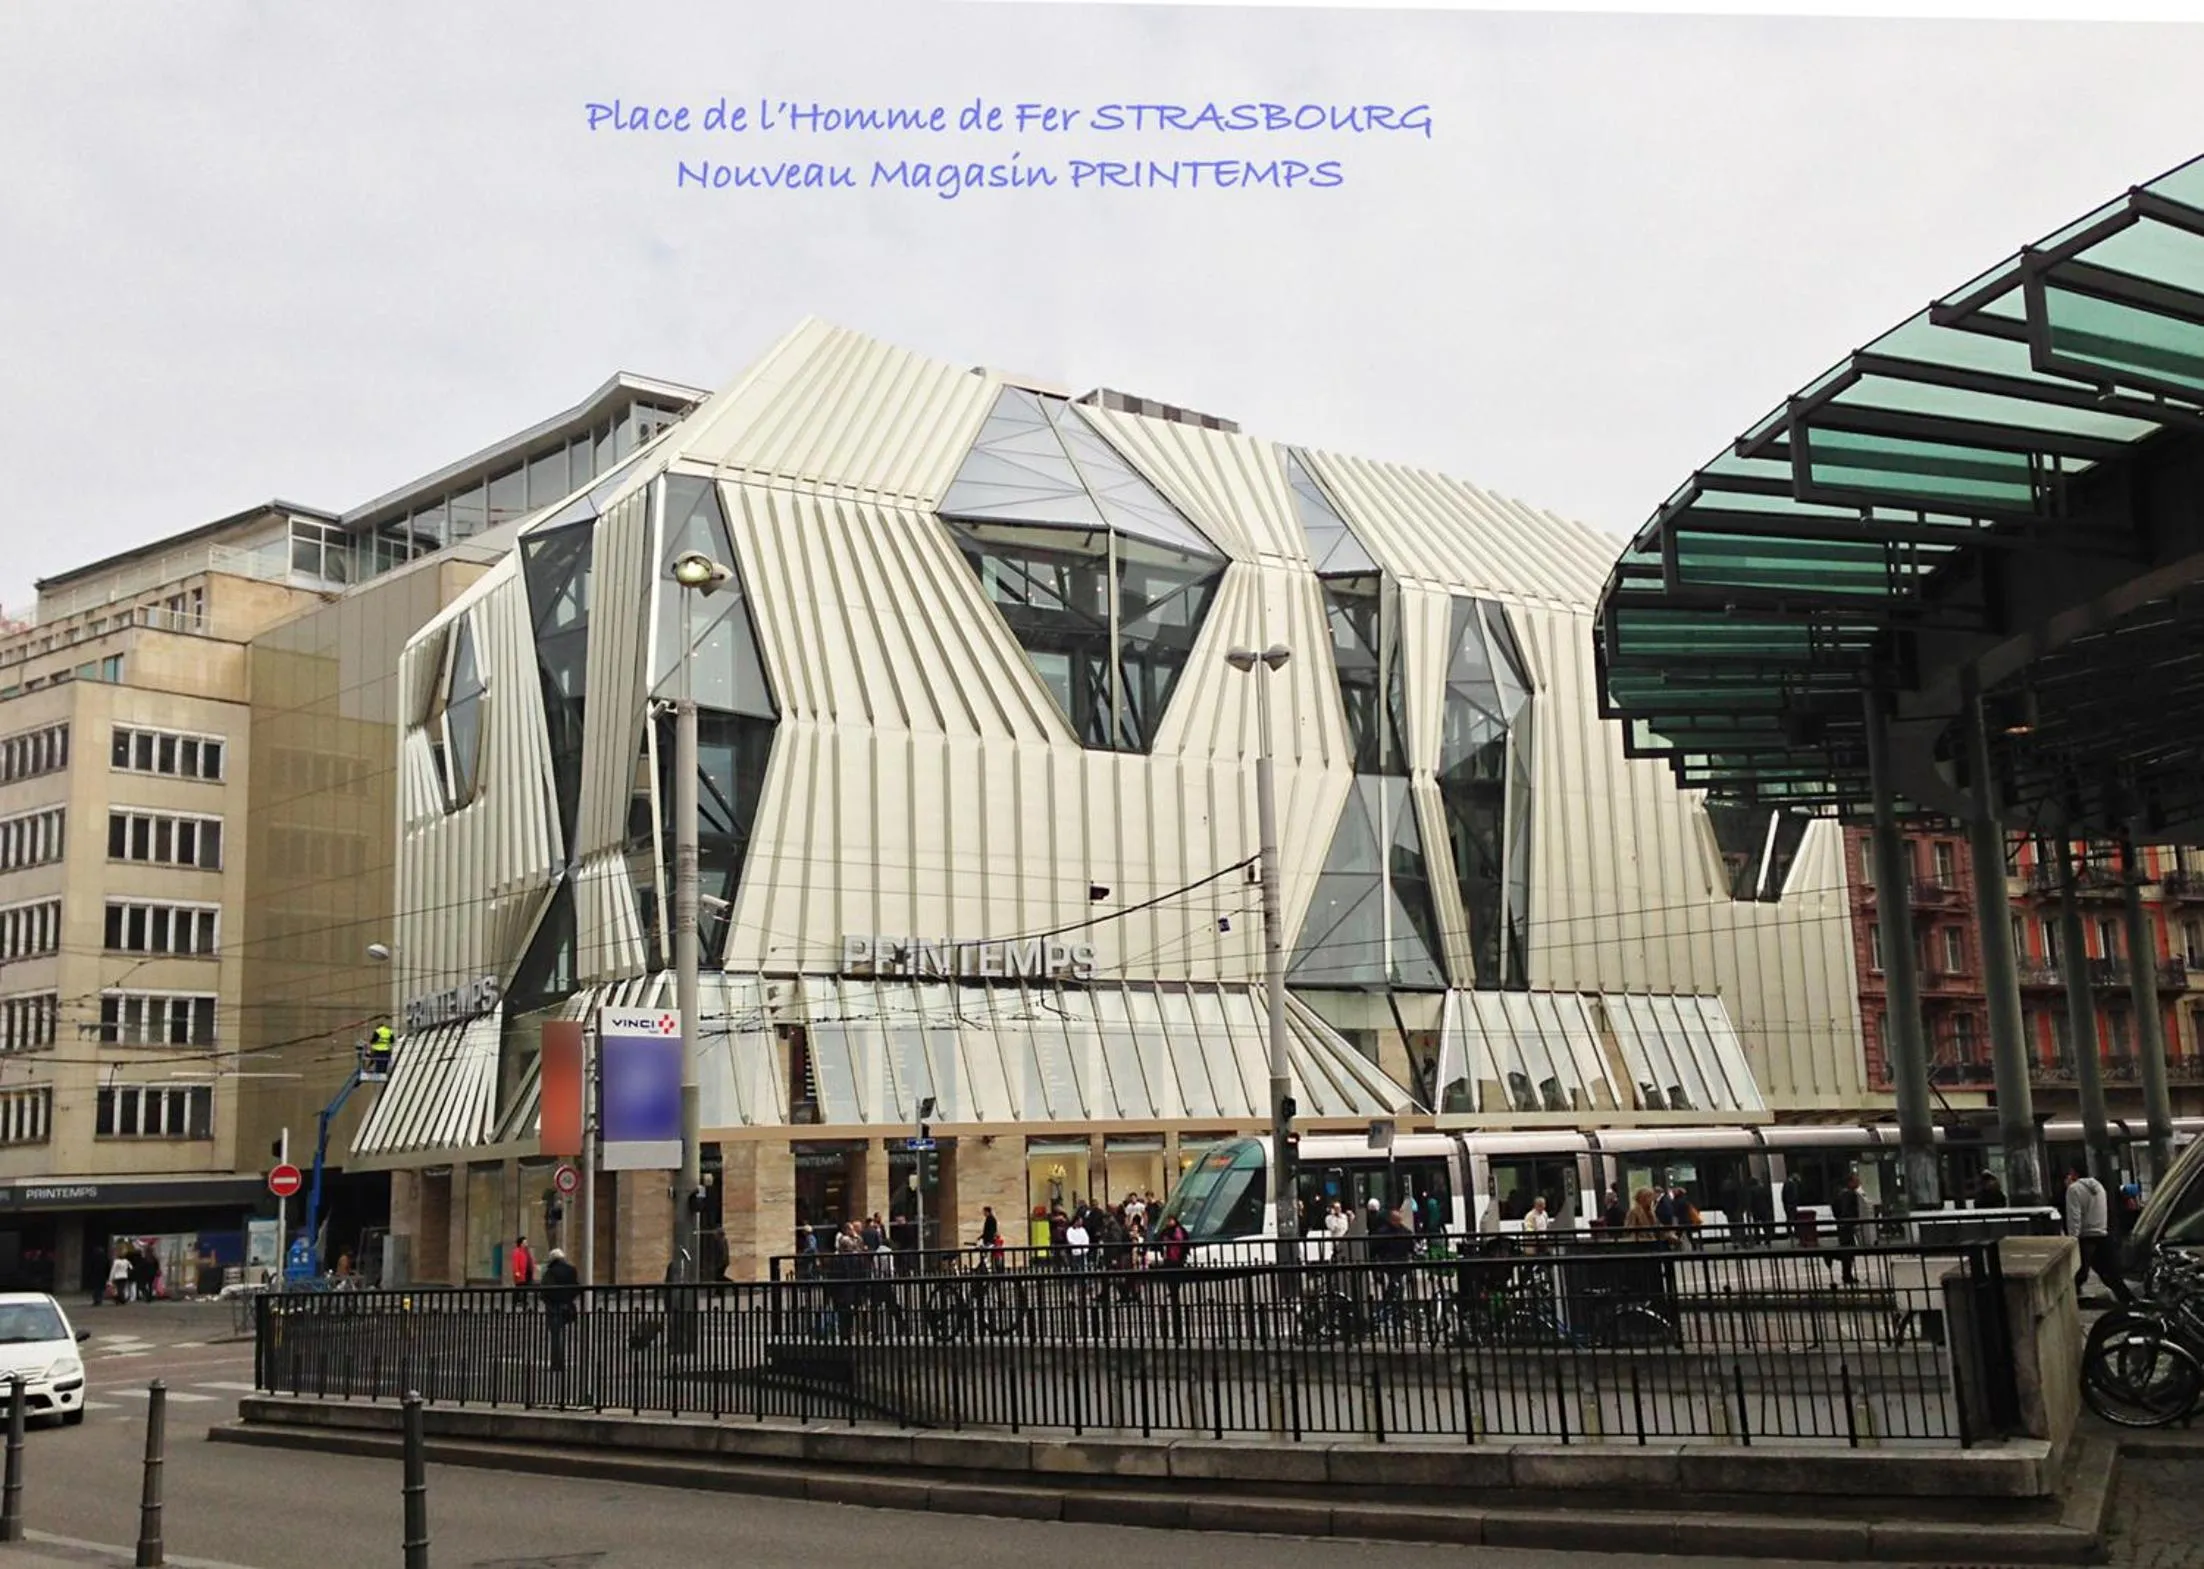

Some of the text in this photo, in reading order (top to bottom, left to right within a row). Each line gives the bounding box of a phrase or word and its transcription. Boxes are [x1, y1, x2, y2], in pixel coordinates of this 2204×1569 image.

[842, 934, 1098, 980] PRINTEMPS
[612, 1019, 655, 1029] VINCI
[25, 1186, 98, 1200] PRINTEMPS
